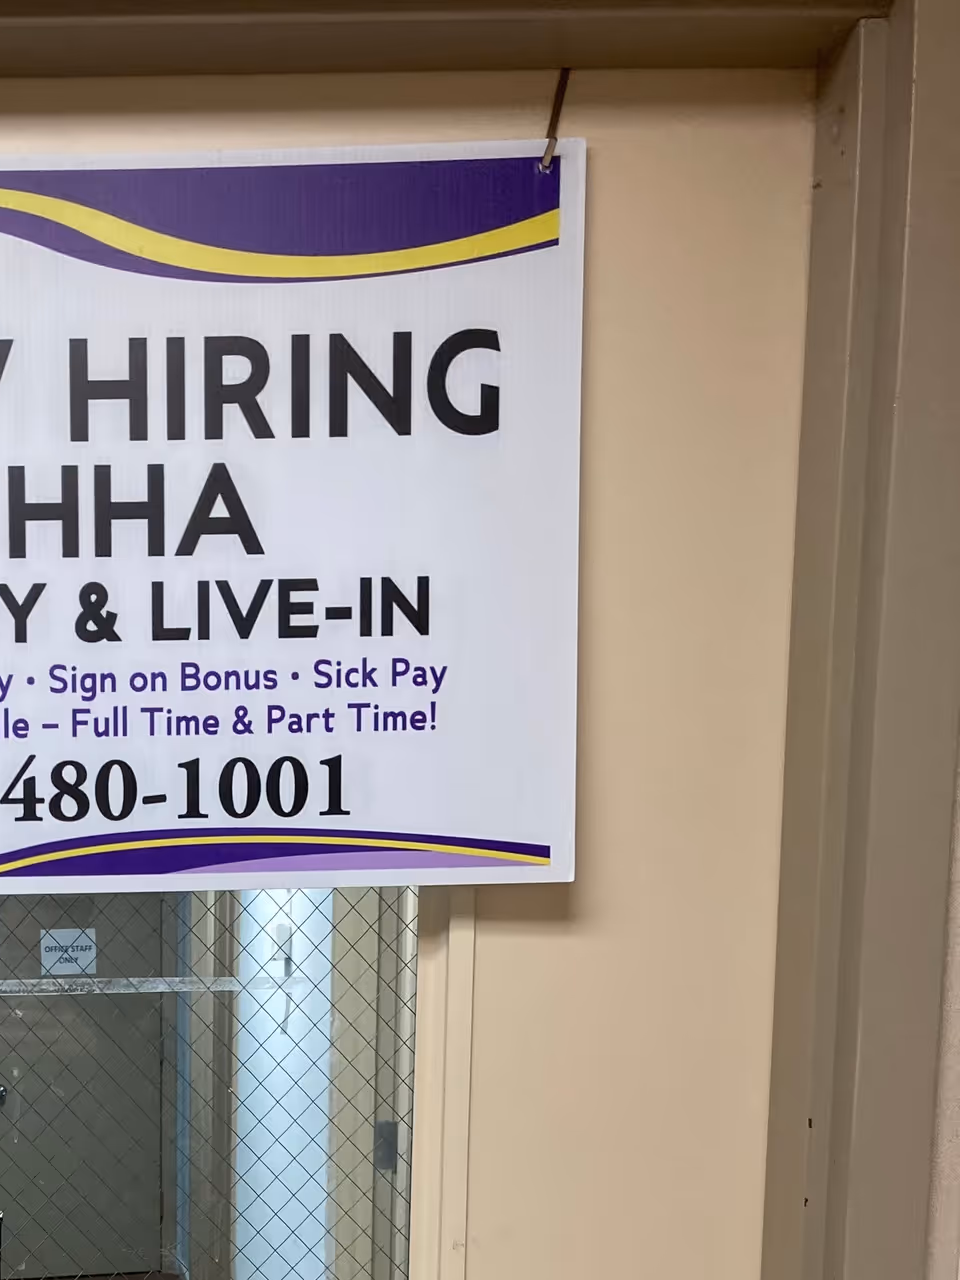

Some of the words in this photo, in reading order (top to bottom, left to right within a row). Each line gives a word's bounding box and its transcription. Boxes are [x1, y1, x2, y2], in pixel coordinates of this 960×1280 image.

[68, 328, 503, 443] HIRING
[74, 581, 123, 644] &
[151, 575, 431, 642] LIVE-IN
[48, 663, 117, 702] Sign
[129, 671, 168, 693] on
[180, 661, 278, 692] Bonus
[313, 656, 379, 689] Sick
[391, 657, 448, 695] Pay
[71, 705, 129, 738] Full
[140, 706, 220, 737] Time
[231, 704, 256, 736] &
[267, 704, 336, 735] Part
[347, 700, 438, 733] Time!
[44, 945, 69, 953] OFFICE
[71, 944, 93, 953] STAFF
[58, 956, 79, 965] ONLY
